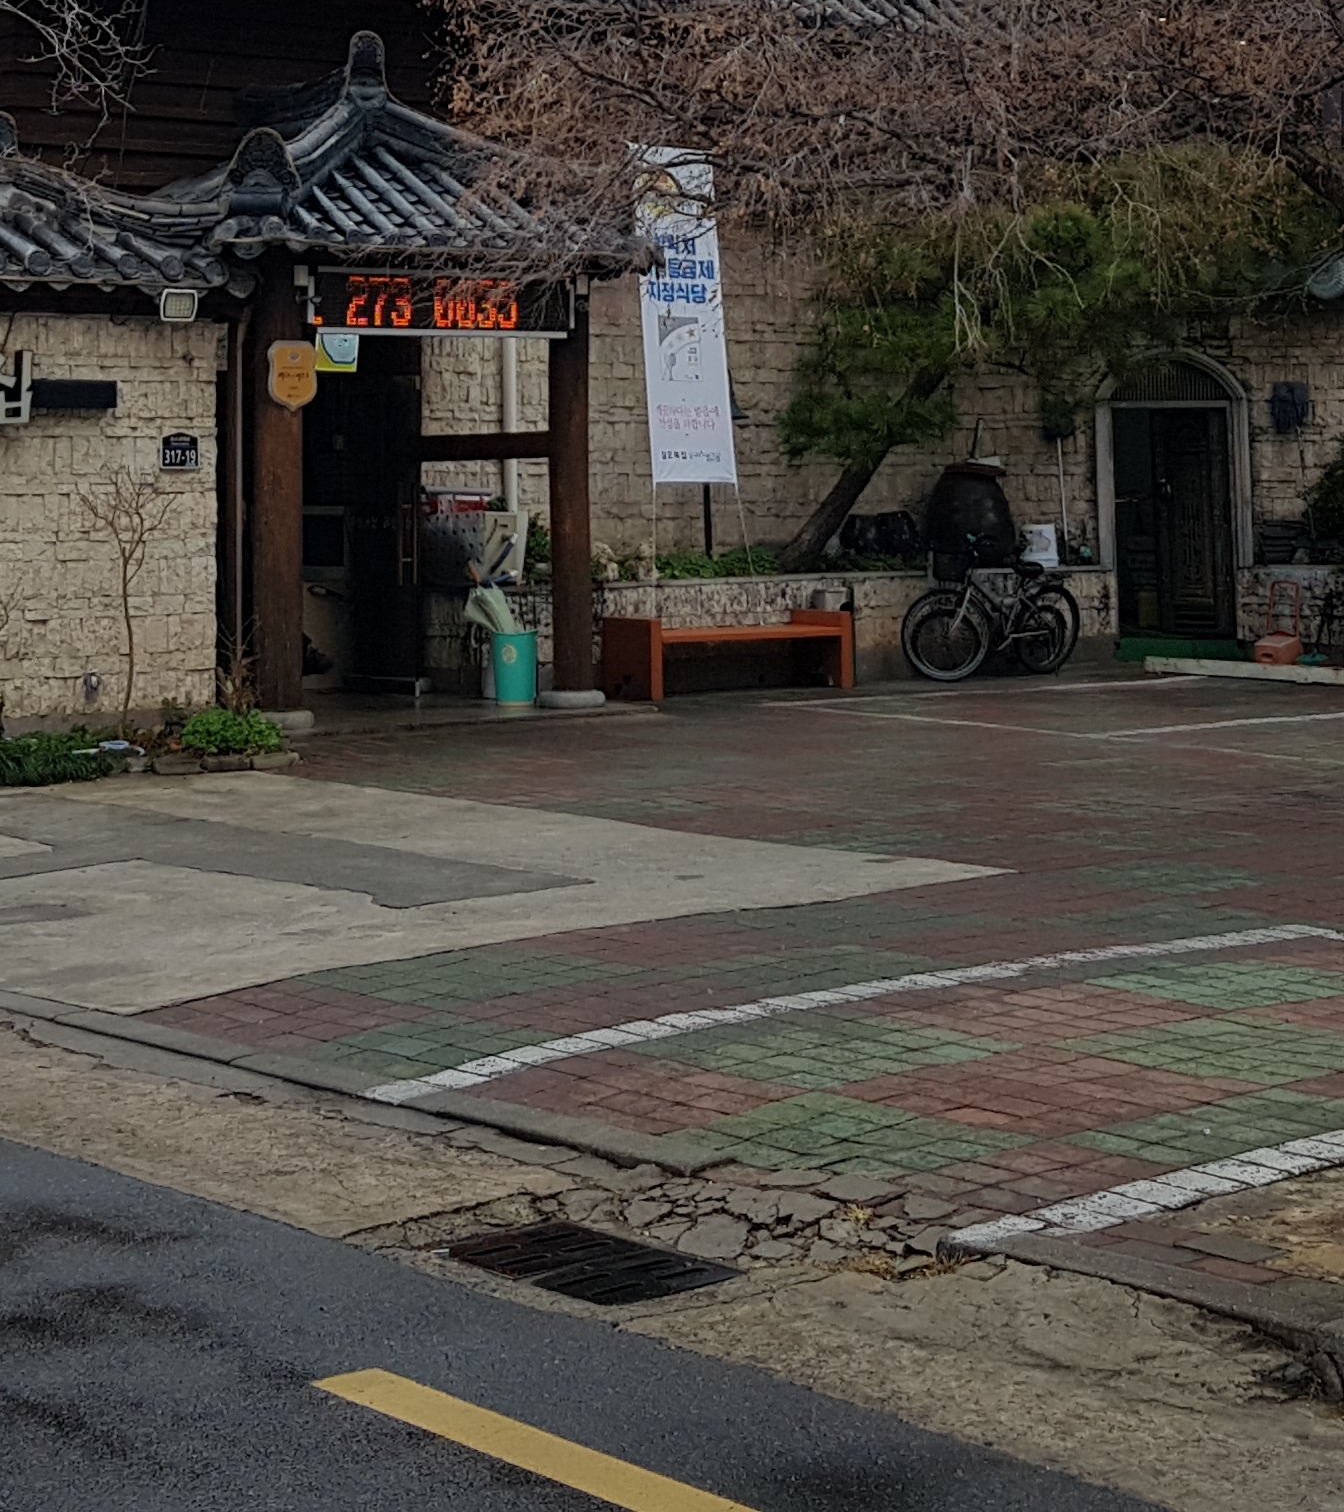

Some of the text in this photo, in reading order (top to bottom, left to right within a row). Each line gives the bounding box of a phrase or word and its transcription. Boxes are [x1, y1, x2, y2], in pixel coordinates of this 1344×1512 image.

[346, 275, 413, 327] 273
[649, 280, 707, 304] 지정식당
[164, 449, 197, 465] 317-19
